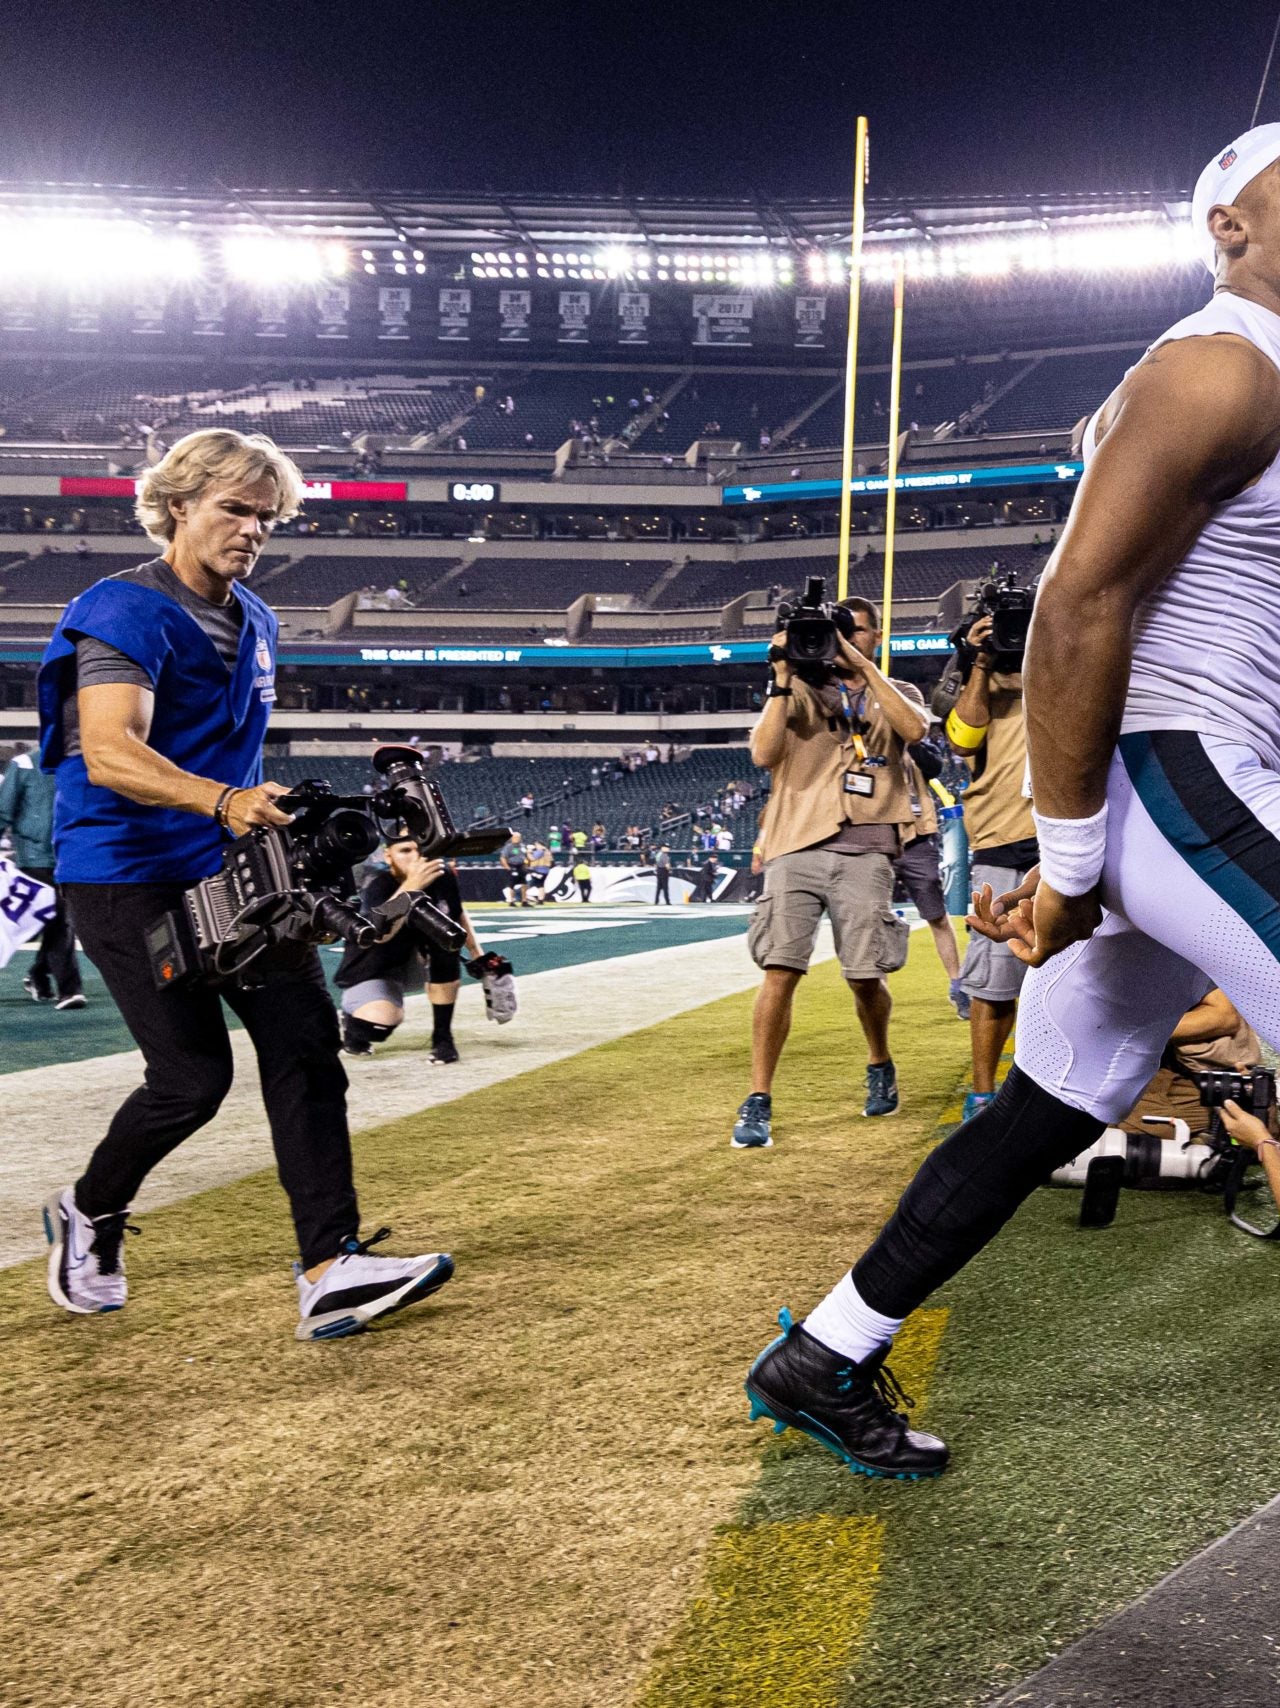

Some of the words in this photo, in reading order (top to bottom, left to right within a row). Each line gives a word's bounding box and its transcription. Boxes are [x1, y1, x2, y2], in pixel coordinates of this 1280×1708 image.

[718, 304, 745, 314] 2017
[905, 474, 959, 488] PRESENTED
[959, 473, 974, 484] BY
[453, 483, 495, 501] 0:00
[890, 640, 915, 652] THIS
[917, 638, 949, 650] GAME
[360, 649, 388, 660] THIS
[389, 649, 423, 661] GAME
[425, 650, 437, 661] IS
[438, 650, 504, 661] PRESENTED
[505, 651, 522, 662] BY
